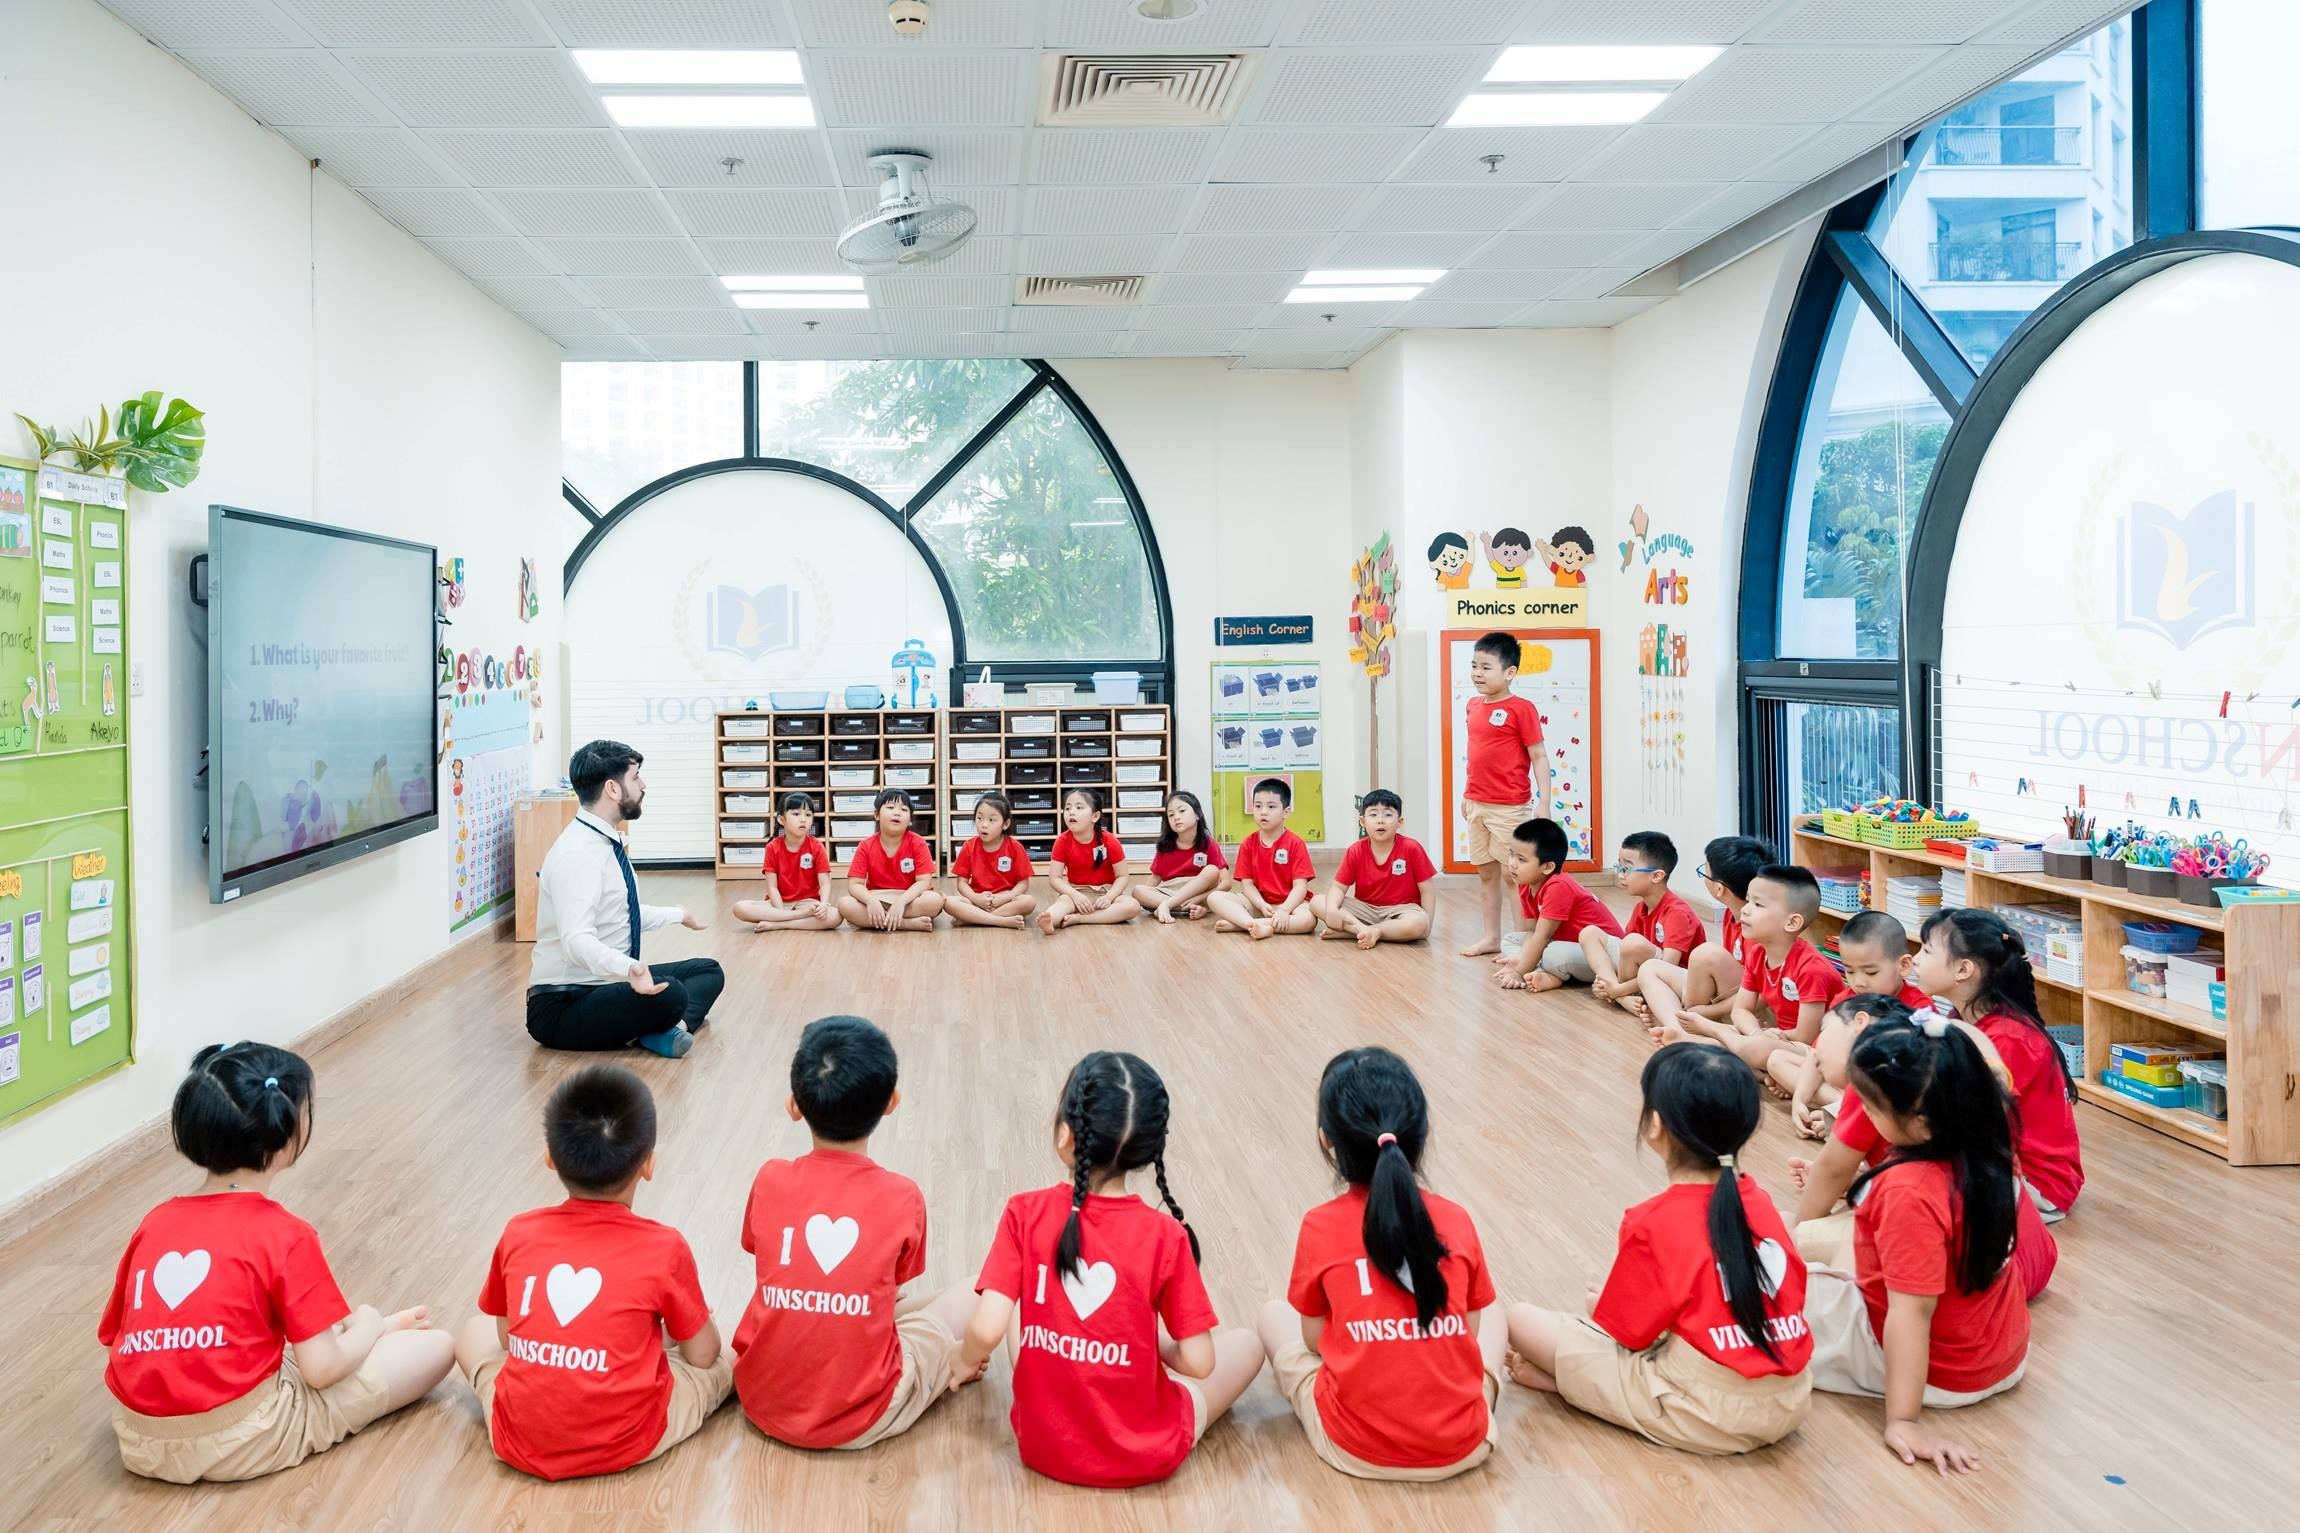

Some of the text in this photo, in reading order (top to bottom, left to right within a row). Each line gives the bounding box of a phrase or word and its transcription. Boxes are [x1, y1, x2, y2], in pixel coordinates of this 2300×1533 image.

[1642, 533, 1694, 565] Language
[1644, 568, 1688, 605] Arts
[1457, 599, 1579, 615] Phonics corner
[1222, 623, 1310, 639] English Corner
[262, 643, 298, 666] What
[301, 641, 311, 665] is
[313, 647, 339, 671] your
[341, 642, 383, 664] favorite
[262, 697, 300, 726] Why?
[91, 721, 120, 745] Akeyo
[74, 856, 104, 877] Weather
[779, 1226, 795, 1266] I
[134, 1269, 147, 1310] I
[1034, 1263, 1048, 1305] I
[1355, 1258, 1373, 1297] I
[519, 1275, 538, 1317] I
[762, 1285, 872, 1317] VINSCHOOL
